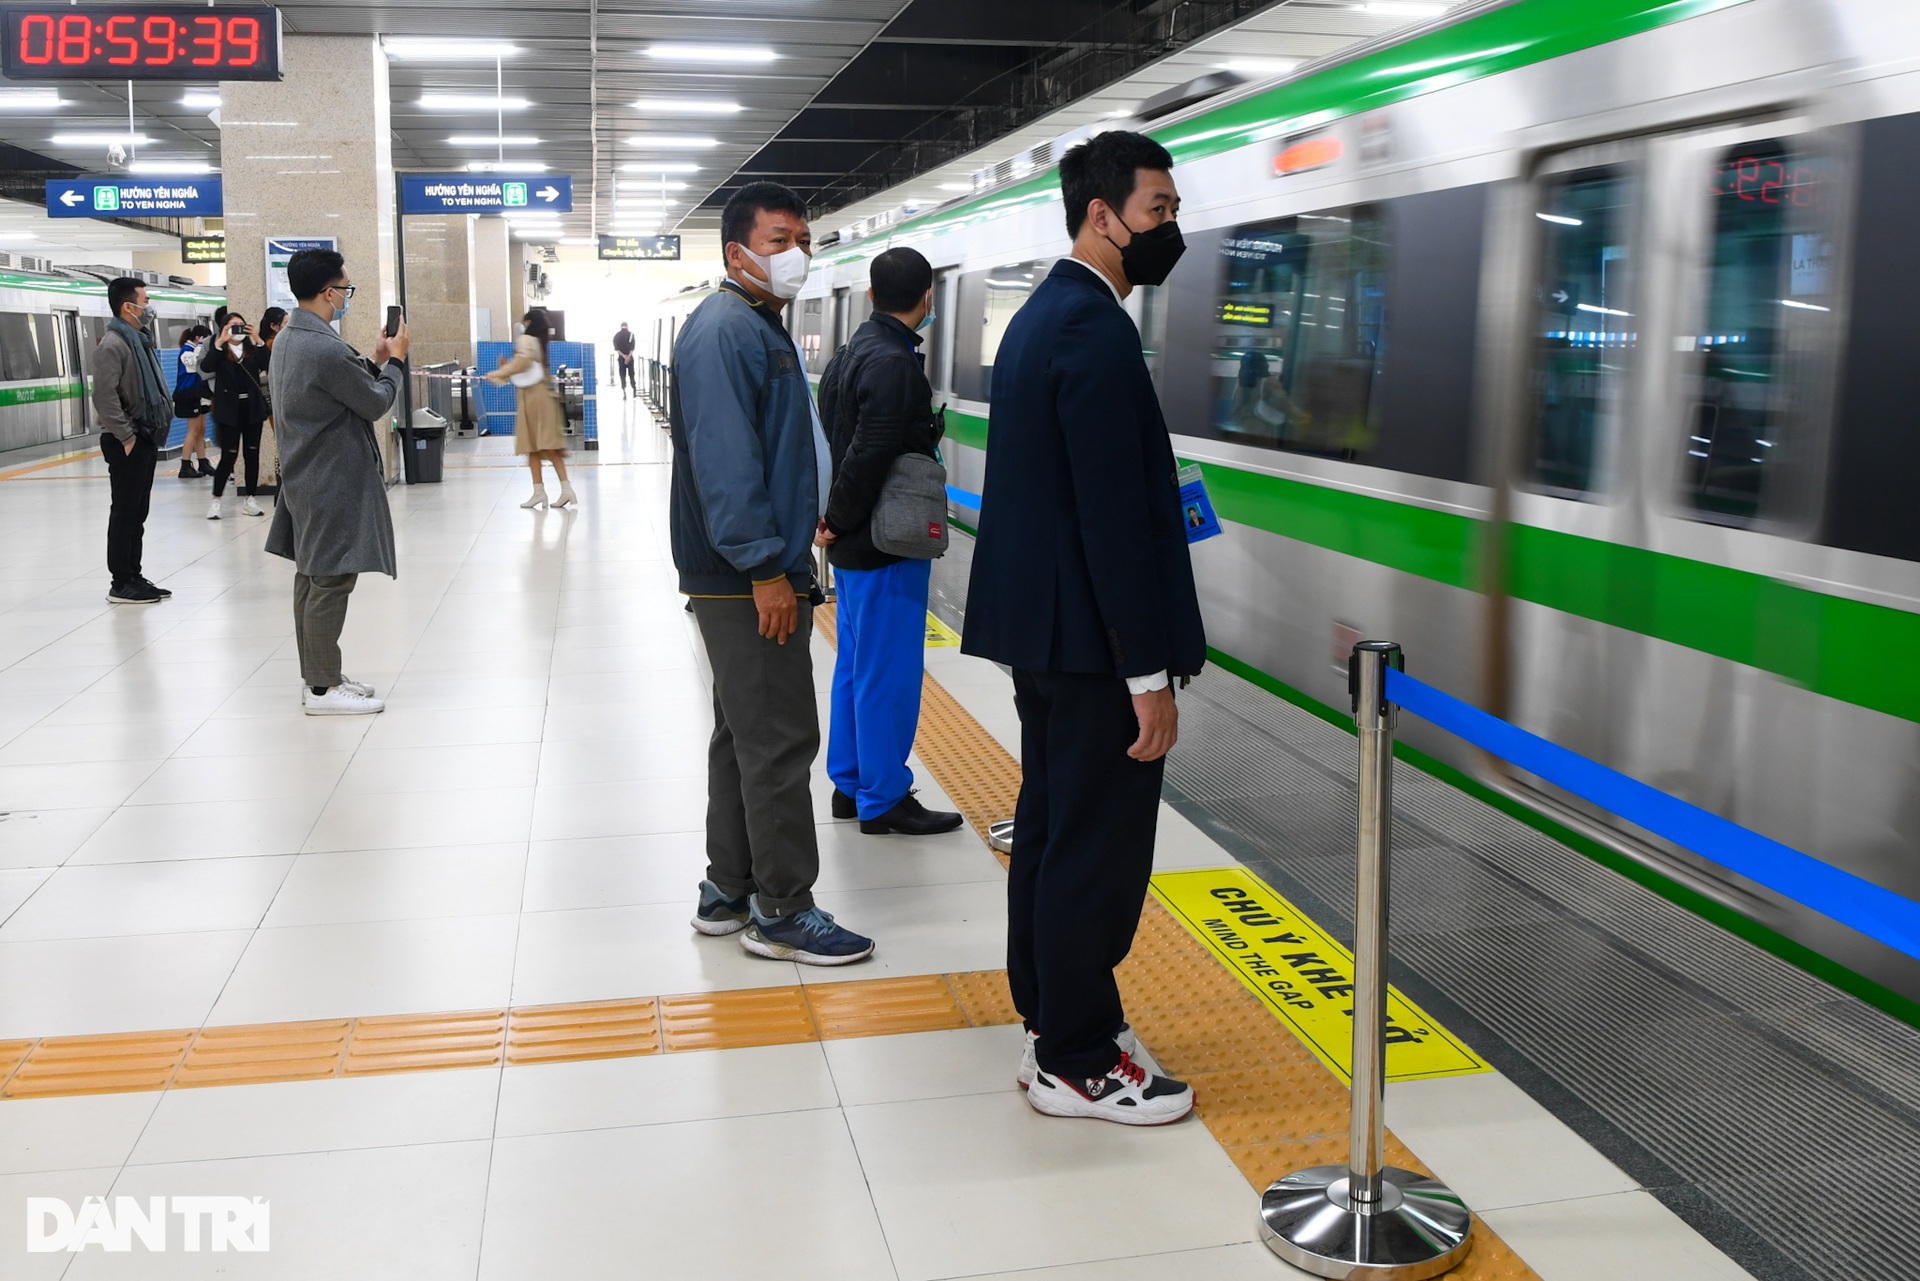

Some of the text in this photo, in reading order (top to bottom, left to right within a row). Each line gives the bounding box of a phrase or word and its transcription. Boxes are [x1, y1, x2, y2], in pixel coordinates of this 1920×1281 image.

[20, 14, 260, 66] 08:59:39
[120, 186, 199, 198] HƯỚNG YÊN NGHĨA
[425, 182, 502, 196] HƯỚNG YÊN NGHĨA
[121, 200, 186, 209] TO YEN NGHIA
[442, 198, 502, 206] TO YEN NGHIA
[1210, 886, 1286, 928] CHÚ
[1262, 931, 1304, 946] Ý
[1201, 918, 1315, 1012] MIND THE GAP
[1280, 952, 1354, 1000] KHE
